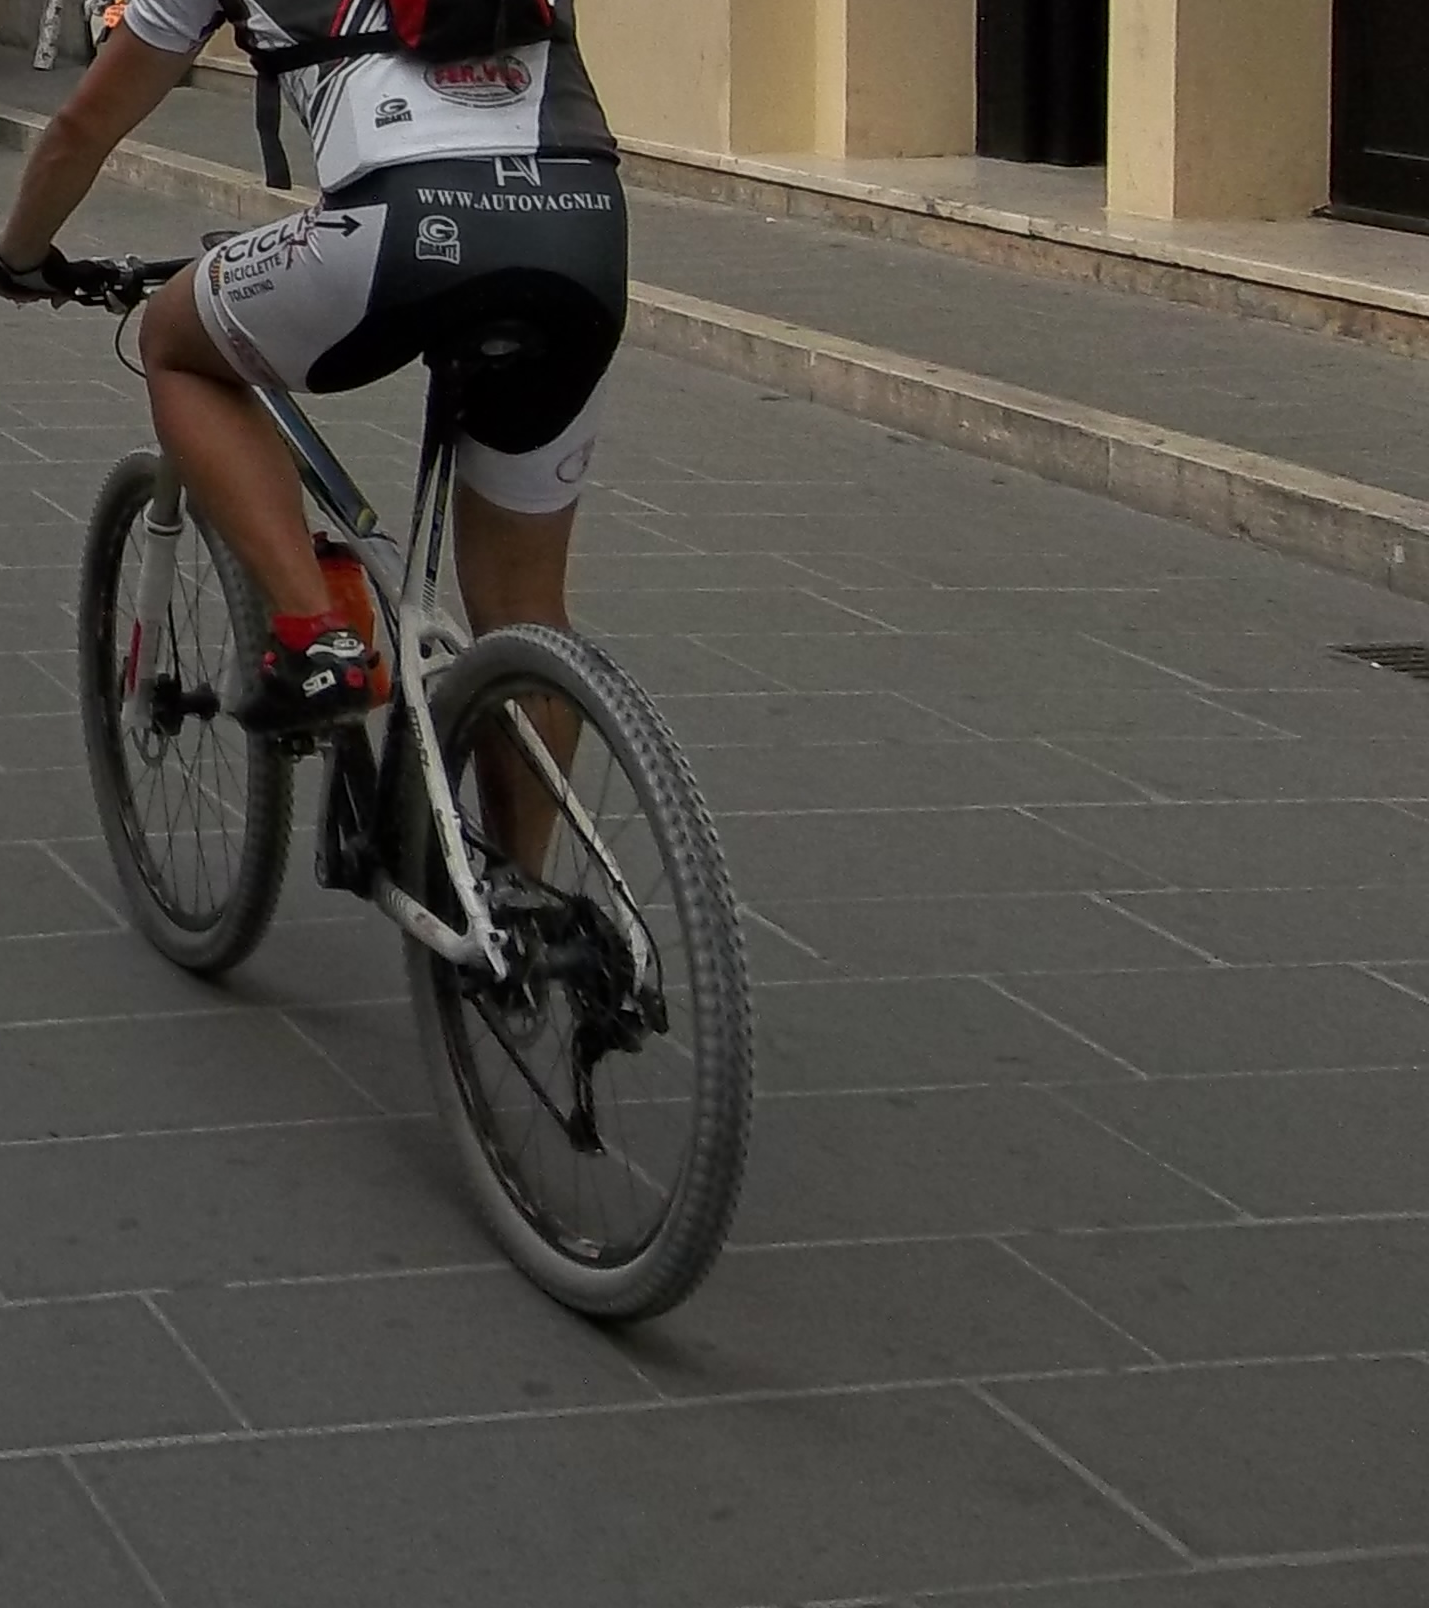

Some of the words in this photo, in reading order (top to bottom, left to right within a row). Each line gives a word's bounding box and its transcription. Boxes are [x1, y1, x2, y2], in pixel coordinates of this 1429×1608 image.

[416, 188, 612, 212] WWW.AUTOVAGNI.IT
[222, 254, 284, 285] BICICLETTE
[227, 278, 275, 303] TOLENTINO
